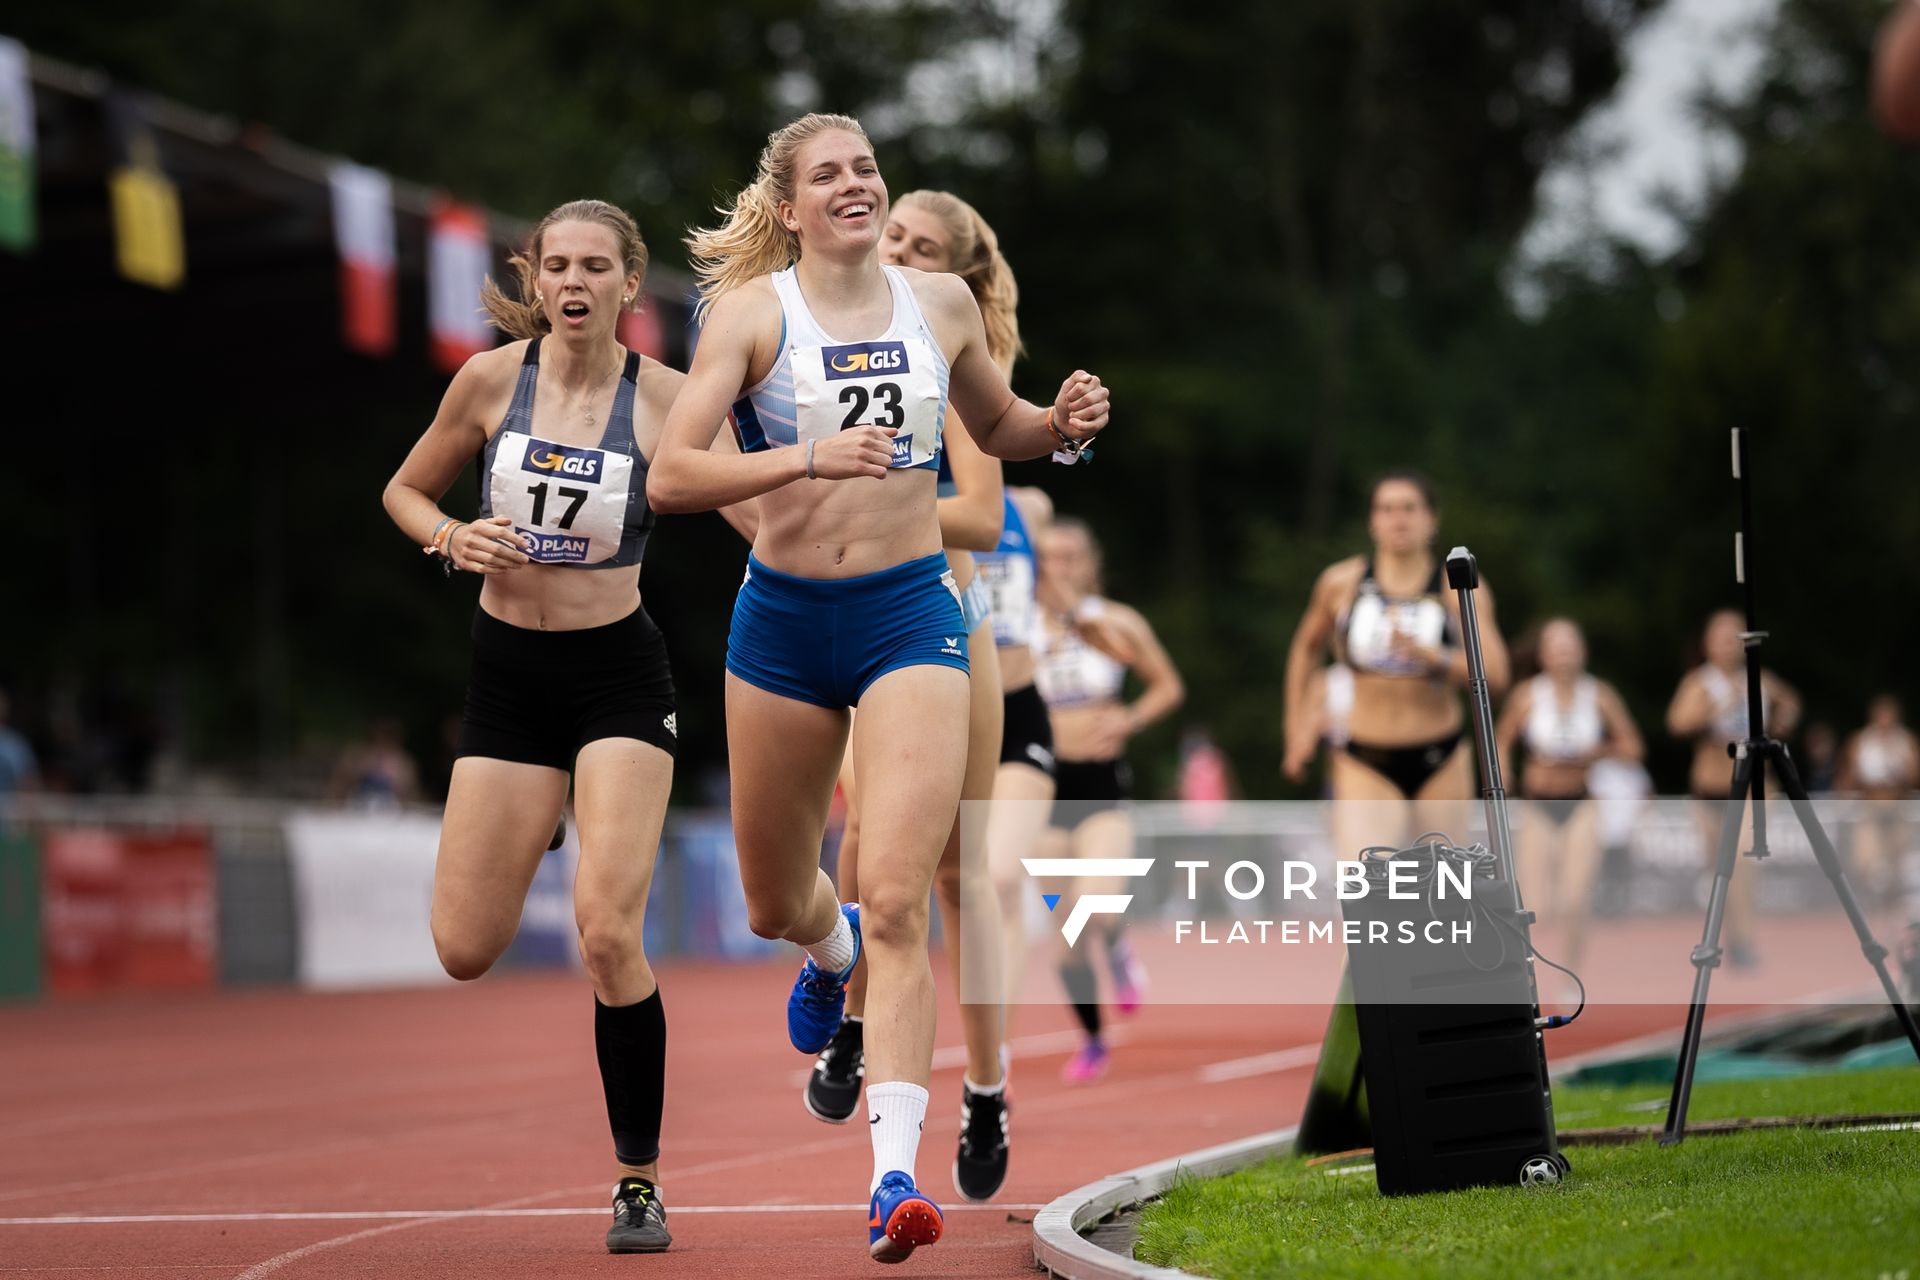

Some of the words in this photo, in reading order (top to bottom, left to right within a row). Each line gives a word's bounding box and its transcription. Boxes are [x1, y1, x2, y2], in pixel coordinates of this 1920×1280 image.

[868, 350, 901, 370] GLS
[838, 382, 905, 432] 23
[892, 441, 910, 456] AN
[562, 456, 597, 476] GLS
[527, 481, 589, 530] 17
[541, 539, 586, 553] PLAN
